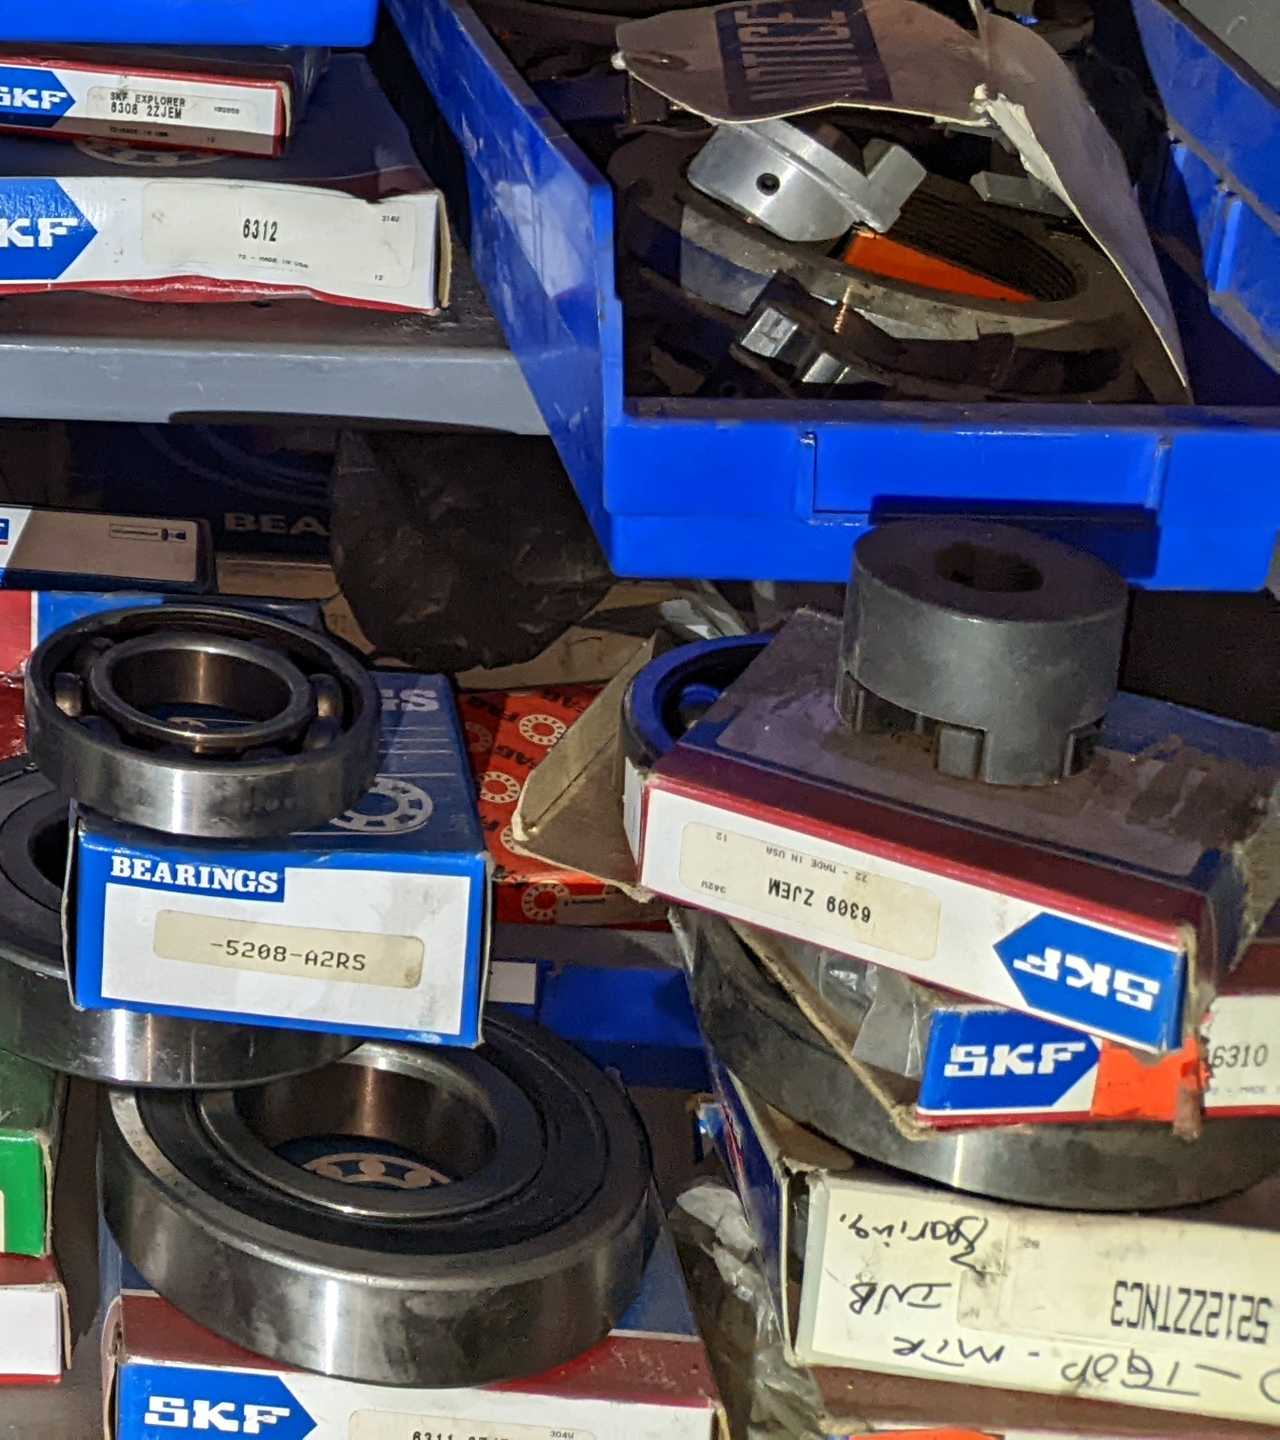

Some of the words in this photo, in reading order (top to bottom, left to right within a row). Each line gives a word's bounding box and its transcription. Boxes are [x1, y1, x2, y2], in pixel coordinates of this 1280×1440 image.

[135, 94, 187, 108] EXPLORER
[146, 105, 182, 119] 2ZJEM
[242, 218, 278, 244] 6312
[764, 845, 786, 858] USA
[808, 857, 837, 873] MADE
[110, 855, 279, 895] BEARINGS
[764, 876, 815, 906] ZJEM
[823, 894, 873, 923] 6309
[210, 938, 367, 973] -5208-A2RS
[1012, 948, 1162, 1013] SKF
[943, 1041, 1086, 1078] SKF
[1212, 1042, 1269, 1069] 6310
[144, 1396, 291, 1434] SKF
